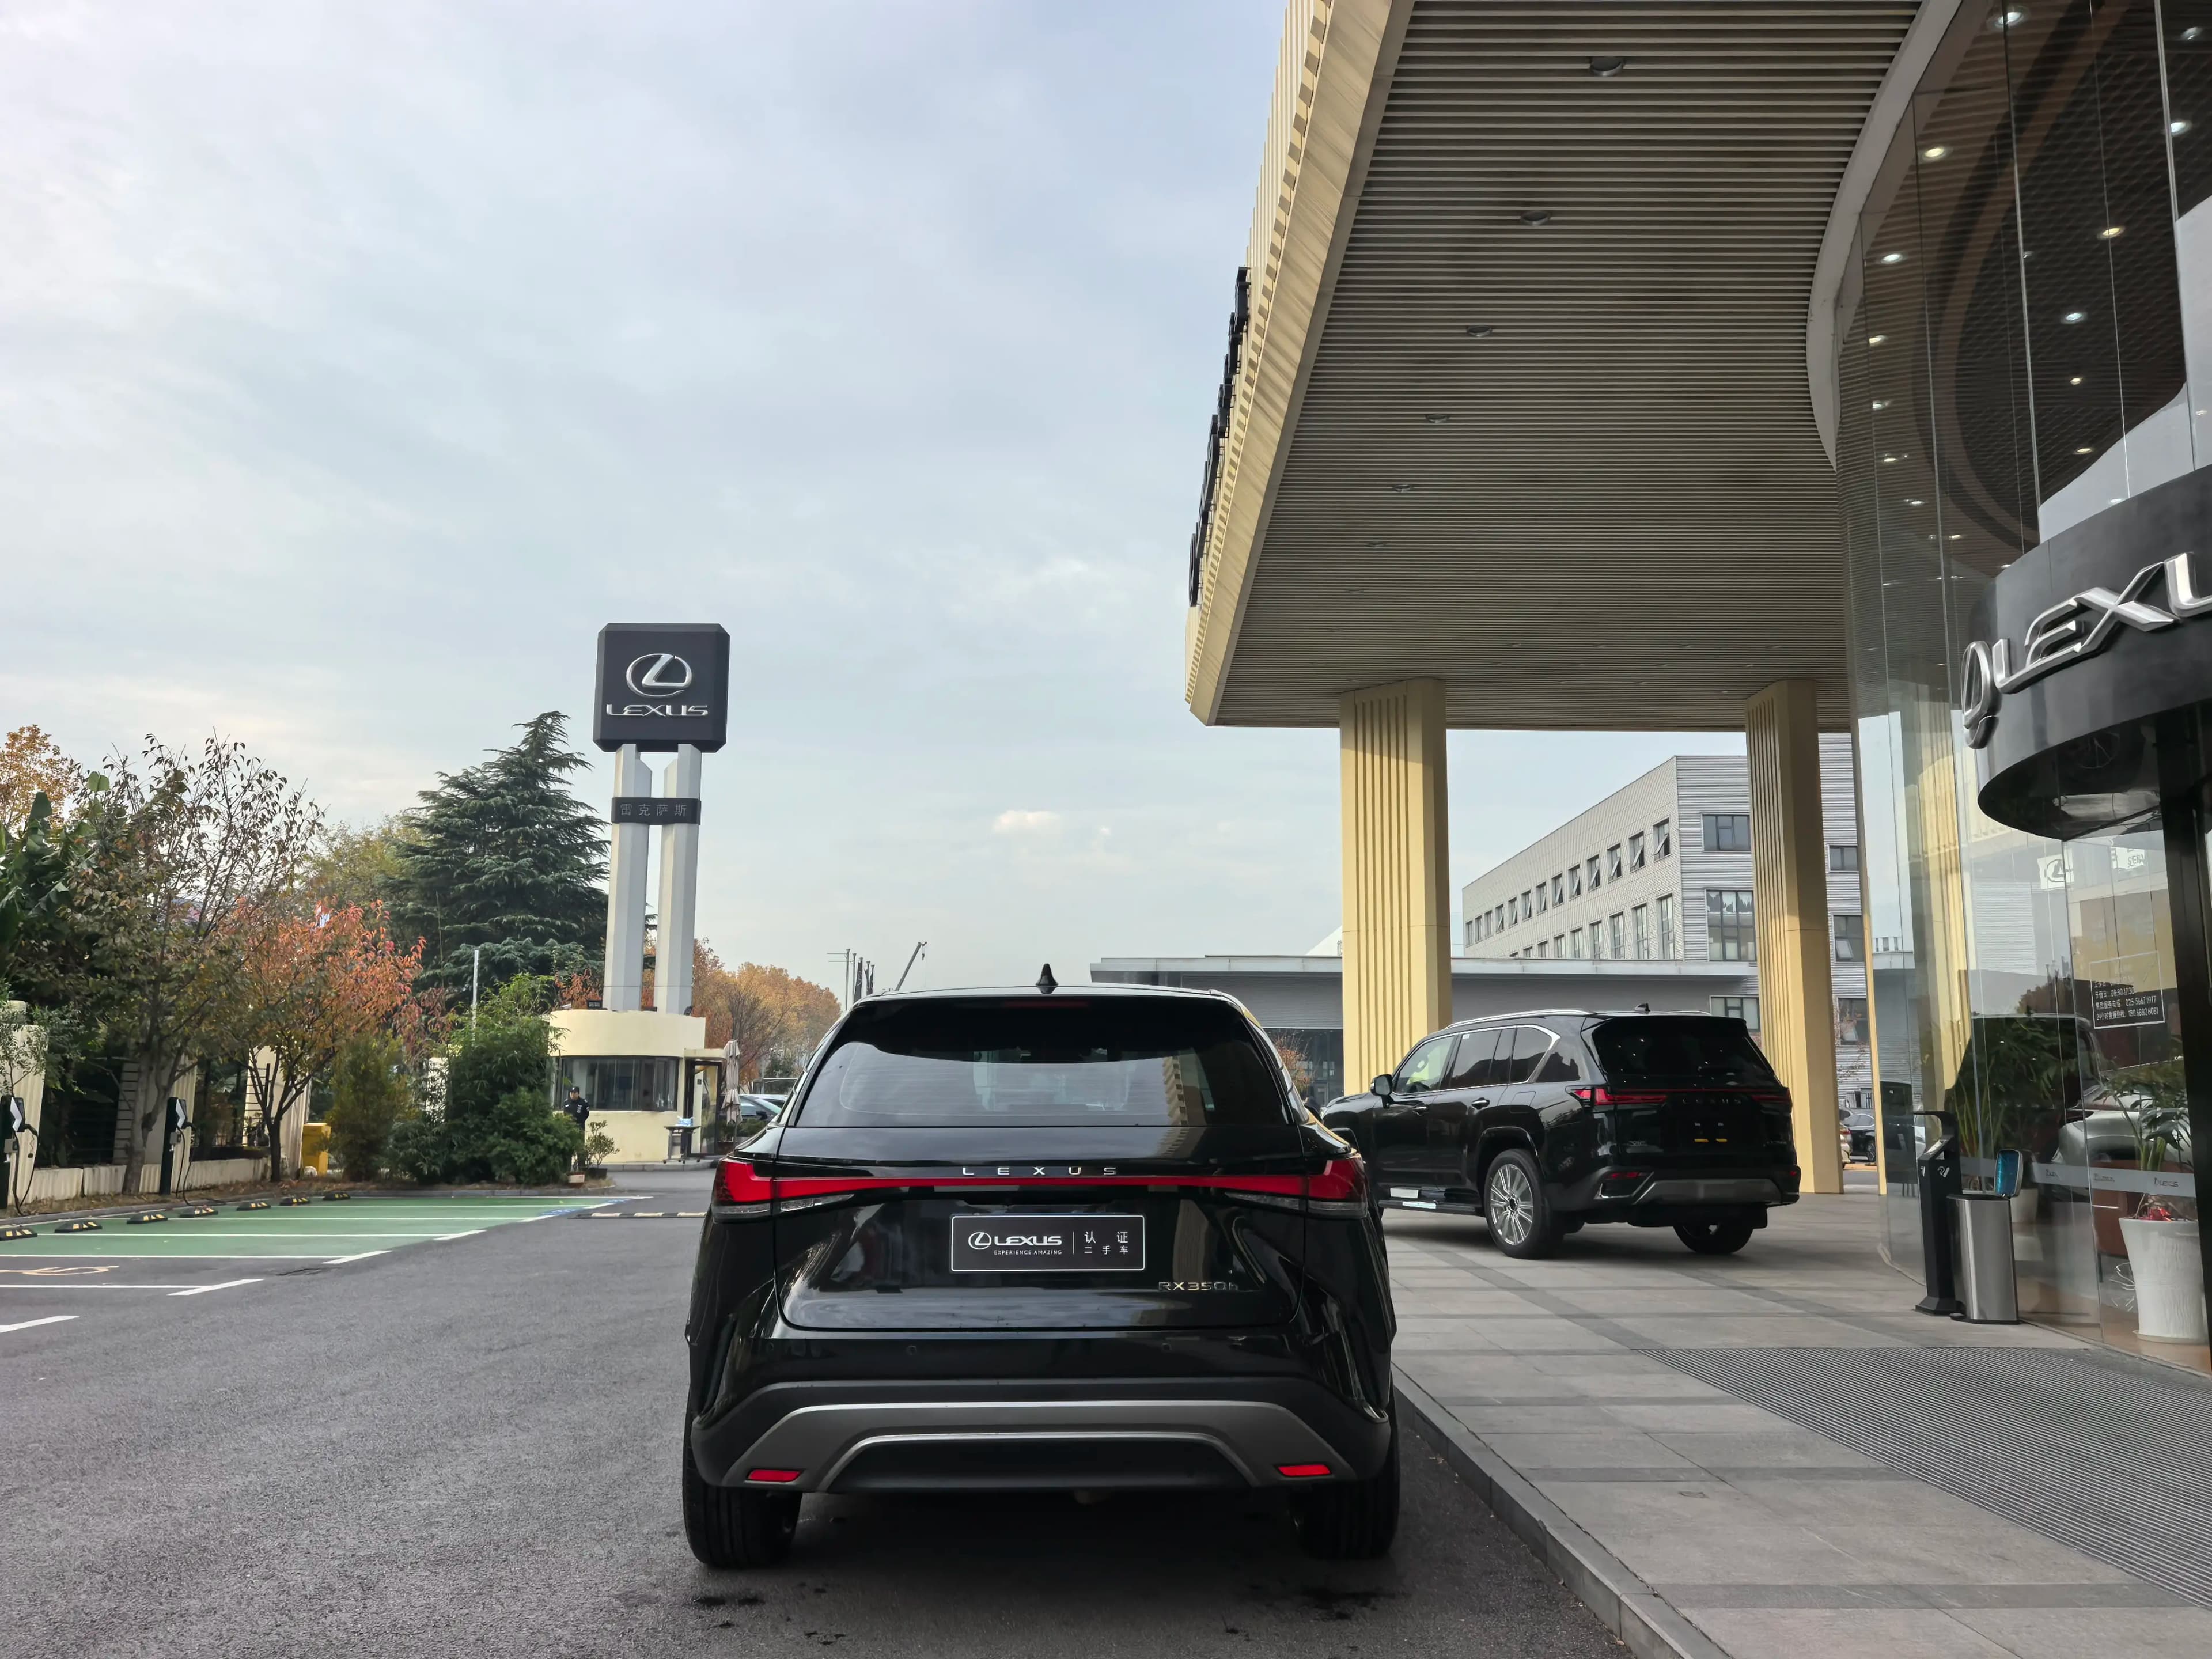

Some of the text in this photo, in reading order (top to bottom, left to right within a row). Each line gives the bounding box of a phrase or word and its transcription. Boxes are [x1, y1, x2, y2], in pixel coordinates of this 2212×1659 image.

[606, 703, 709, 717] LEXUS
[620, 803, 687, 816] 雷克萨斯
[963, 1166, 1116, 1176] LEXUS
[994, 1236, 1062, 1246] LEXUS
[1084, 1230, 1128, 1244] 认证
[1084, 1245, 1128, 1255] 二手车
[1158, 1281, 1239, 1291] RX350h
